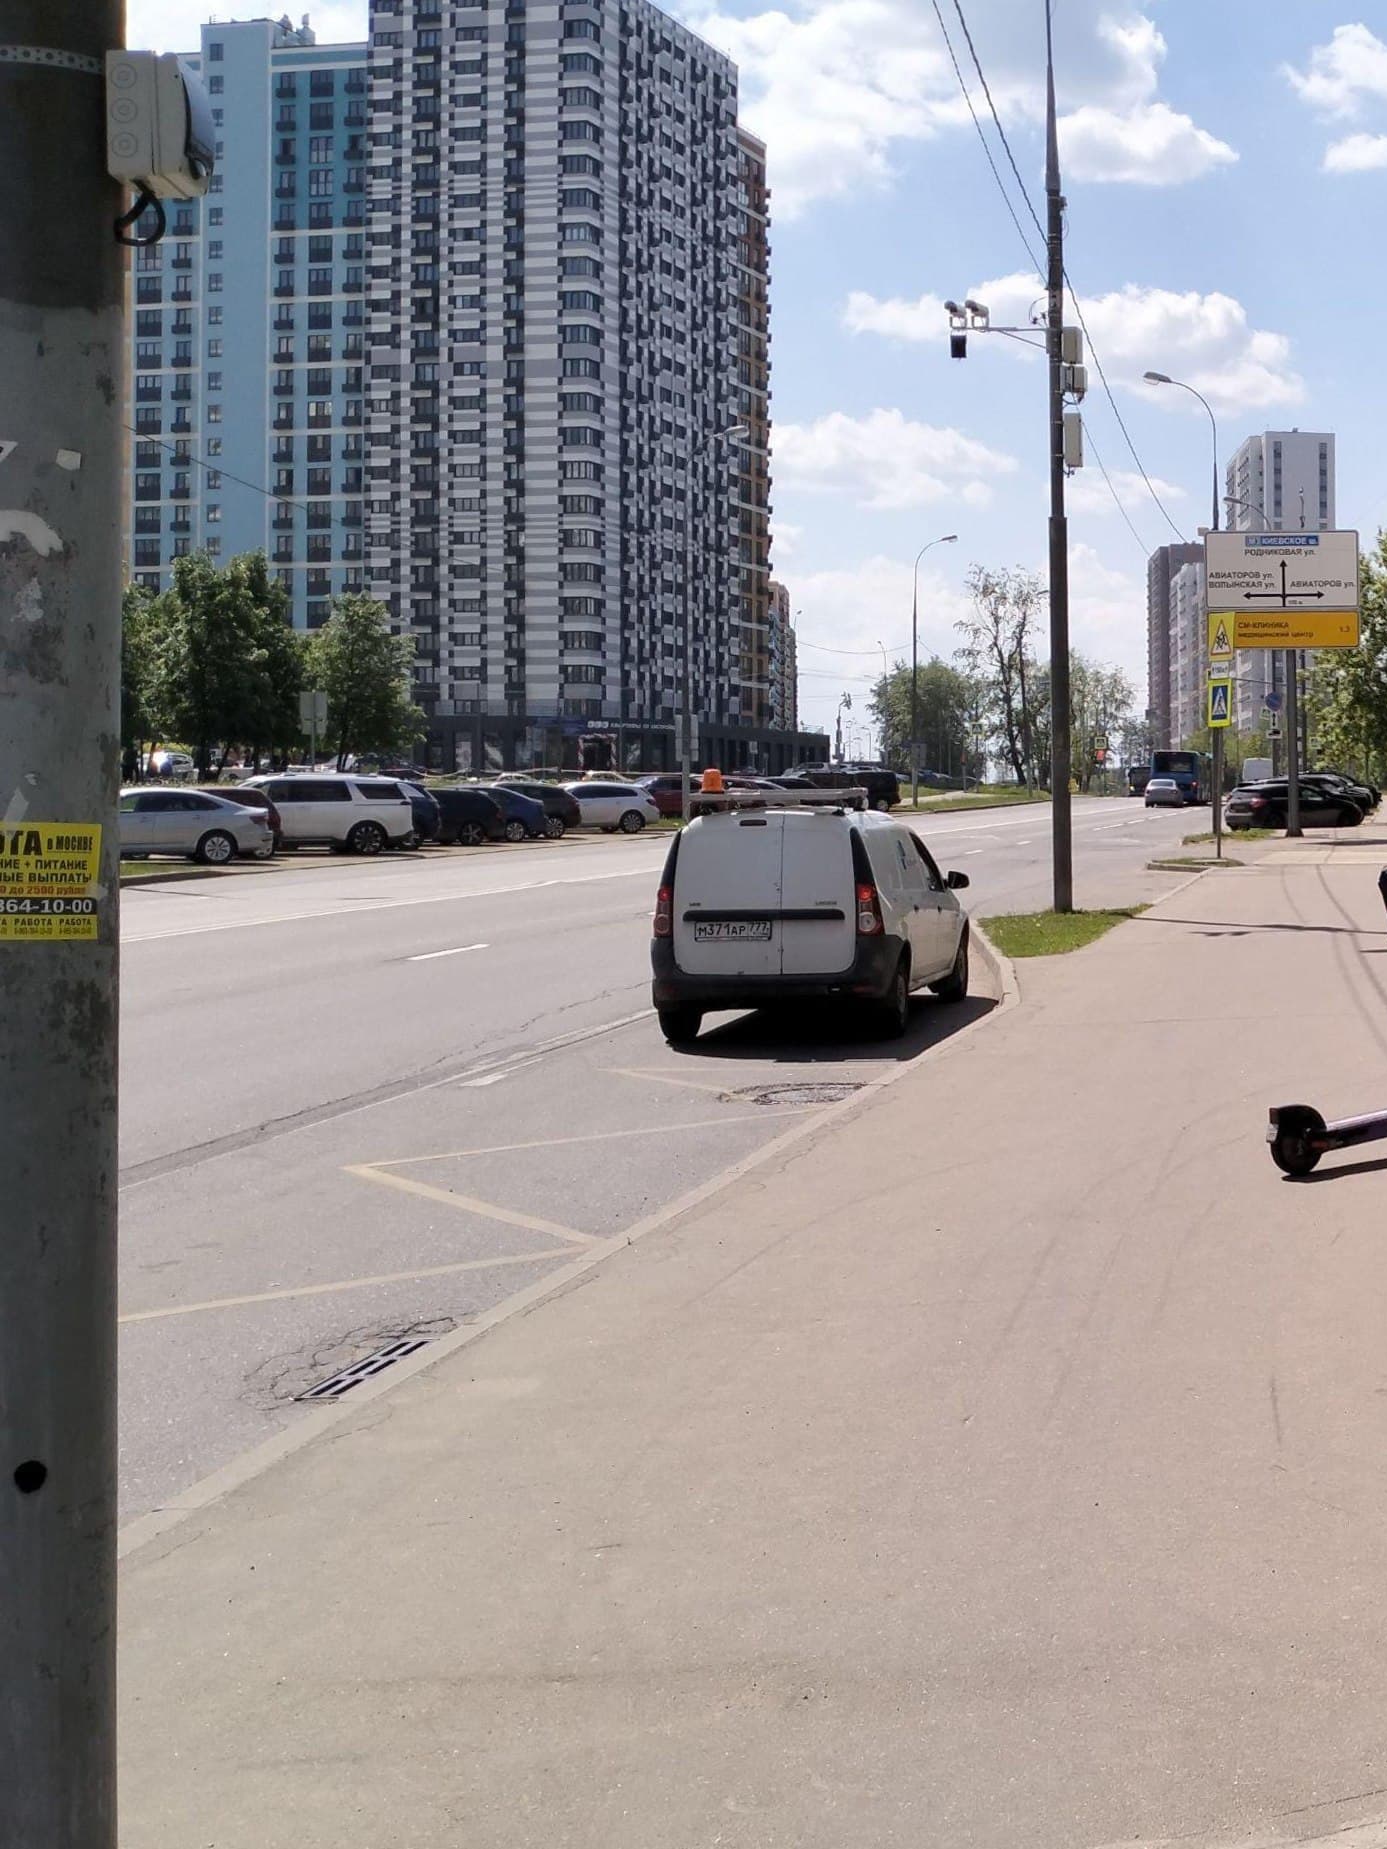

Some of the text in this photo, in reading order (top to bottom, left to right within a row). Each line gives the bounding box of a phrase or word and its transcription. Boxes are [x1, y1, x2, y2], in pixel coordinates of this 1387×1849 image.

[1244, 548, 1315, 558] РОДНИКОВАЯ ул.
[1209, 571, 1274, 581] АВИАТОРОВ ул.
[1208, 581, 1276, 591] ВОЛЫНСКАЯ ул.
[1290, 580, 1355, 590] АВИАТОРОВ ул.
[0, 830, 42, 855] ТА
[55, 835, 93, 851] МОСКВЕ
[35, 860, 88, 871] ПИТАНИЕ
[0, 873, 92, 884] ЫЕ ВЫПЛАТЫ
[14, 918, 53, 926] РАБОТА
[59, 918, 92, 926] РАБОТА
